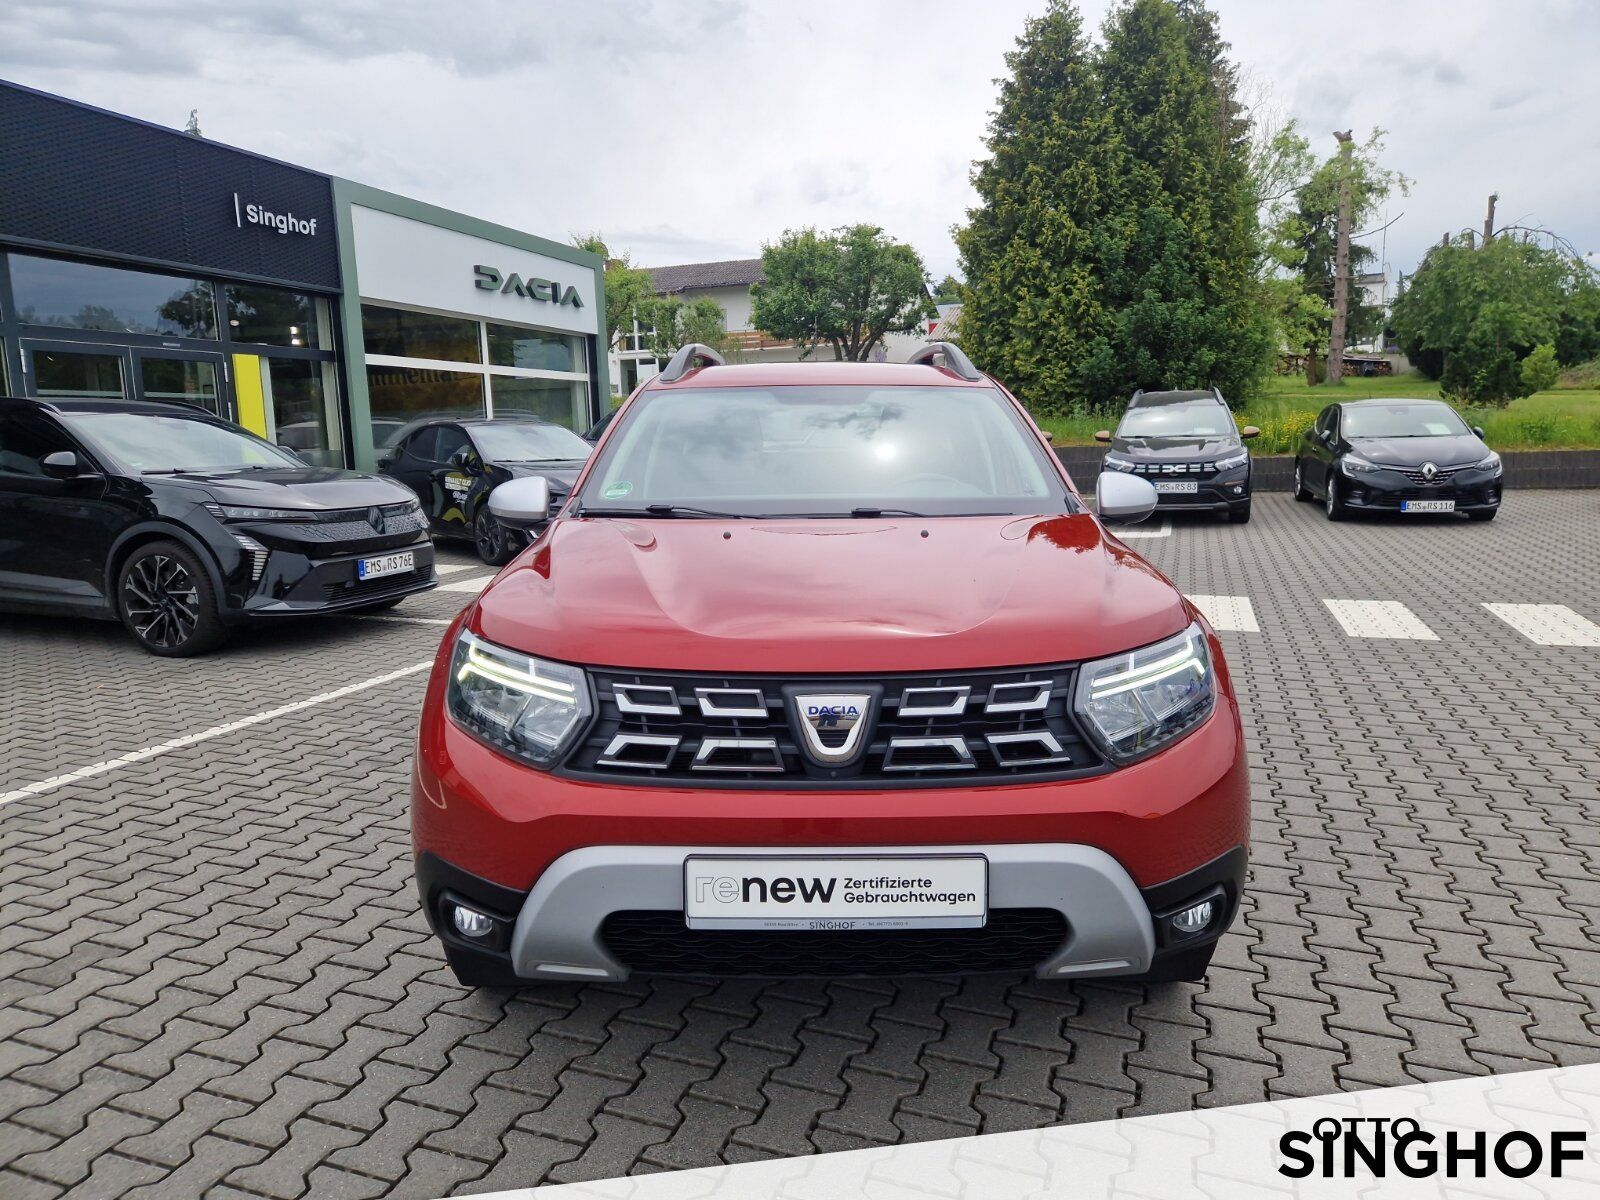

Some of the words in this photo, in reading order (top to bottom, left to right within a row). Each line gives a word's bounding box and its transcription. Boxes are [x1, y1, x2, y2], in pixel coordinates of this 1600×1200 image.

[246, 204, 317, 236] Singhof
[473, 264, 585, 308] DACIA
[1154, 483, 1170, 491] EMS
[1175, 483, 1186, 491] RS
[1187, 483, 1197, 491] 83
[1406, 502, 1422, 510] EMS
[1427, 502, 1438, 510] RS
[1440, 502, 1454, 510] 116
[365, 559, 382, 575] EMS
[387, 556, 398, 571] RS
[399, 553, 413, 569] 76E
[808, 705, 858, 715] DACIA
[843, 877, 933, 889] Zertifizierte
[695, 877, 837, 904] renew
[843, 891, 976, 905] Gebrauchtwagen
[809, 921, 856, 930] SINGHOF
